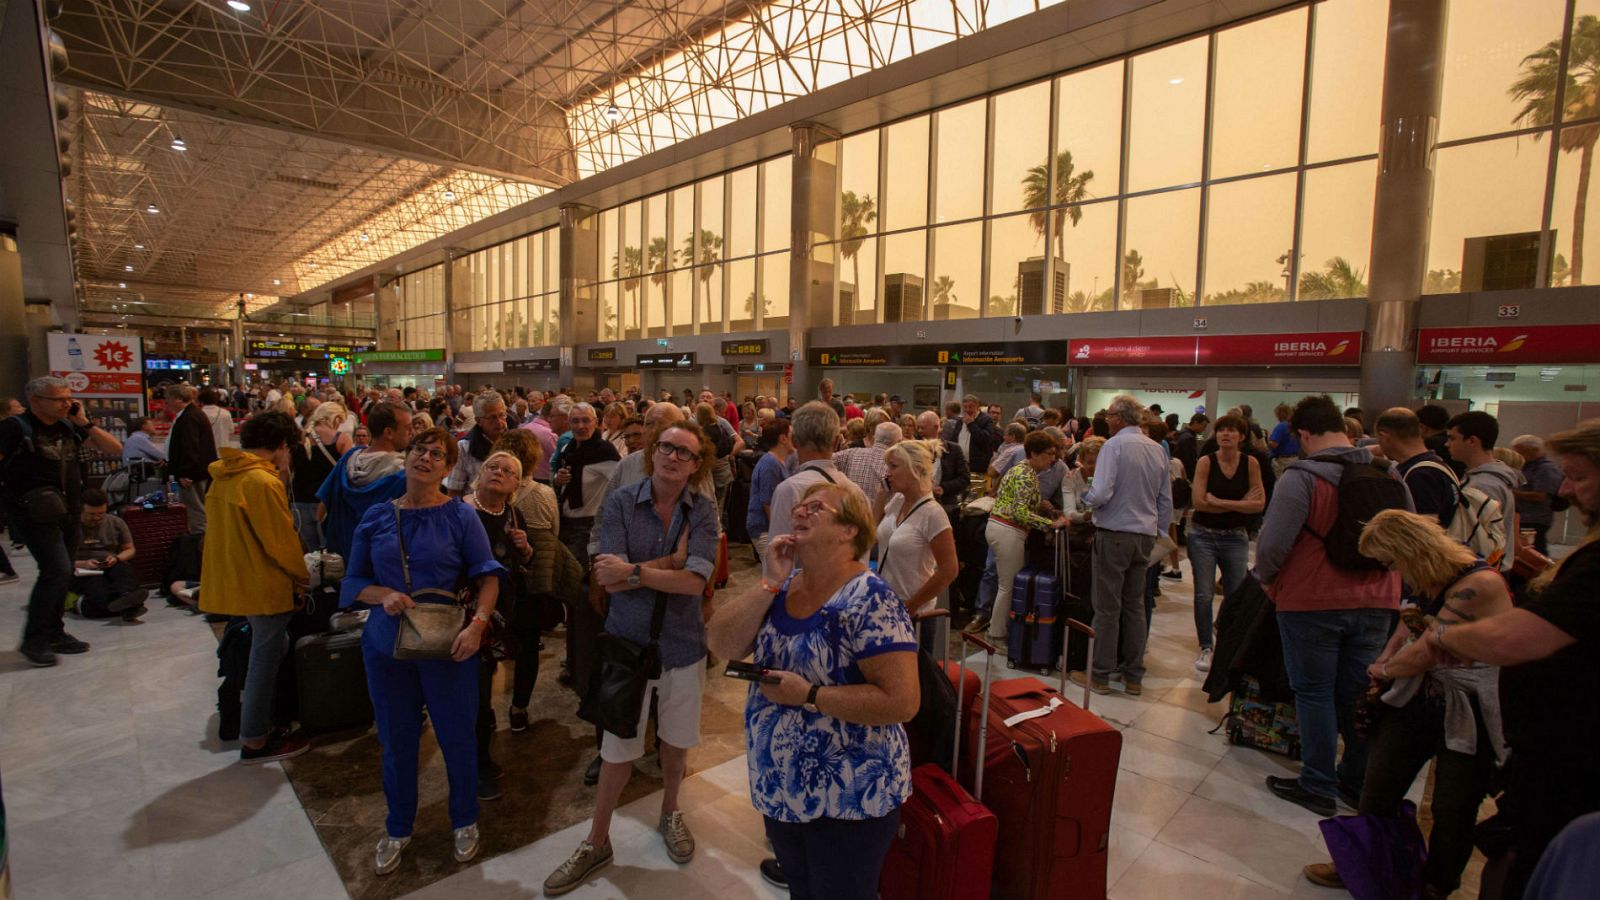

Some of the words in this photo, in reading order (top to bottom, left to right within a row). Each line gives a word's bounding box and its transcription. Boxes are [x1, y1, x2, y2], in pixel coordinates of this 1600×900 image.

[1499, 306, 1518, 316] 33
[1195, 319, 1206, 328] 34
[1274, 342, 1327, 351] IBERIA
[1431, 337, 1498, 347] IBERIA
[103, 348, 124, 362] 1€
